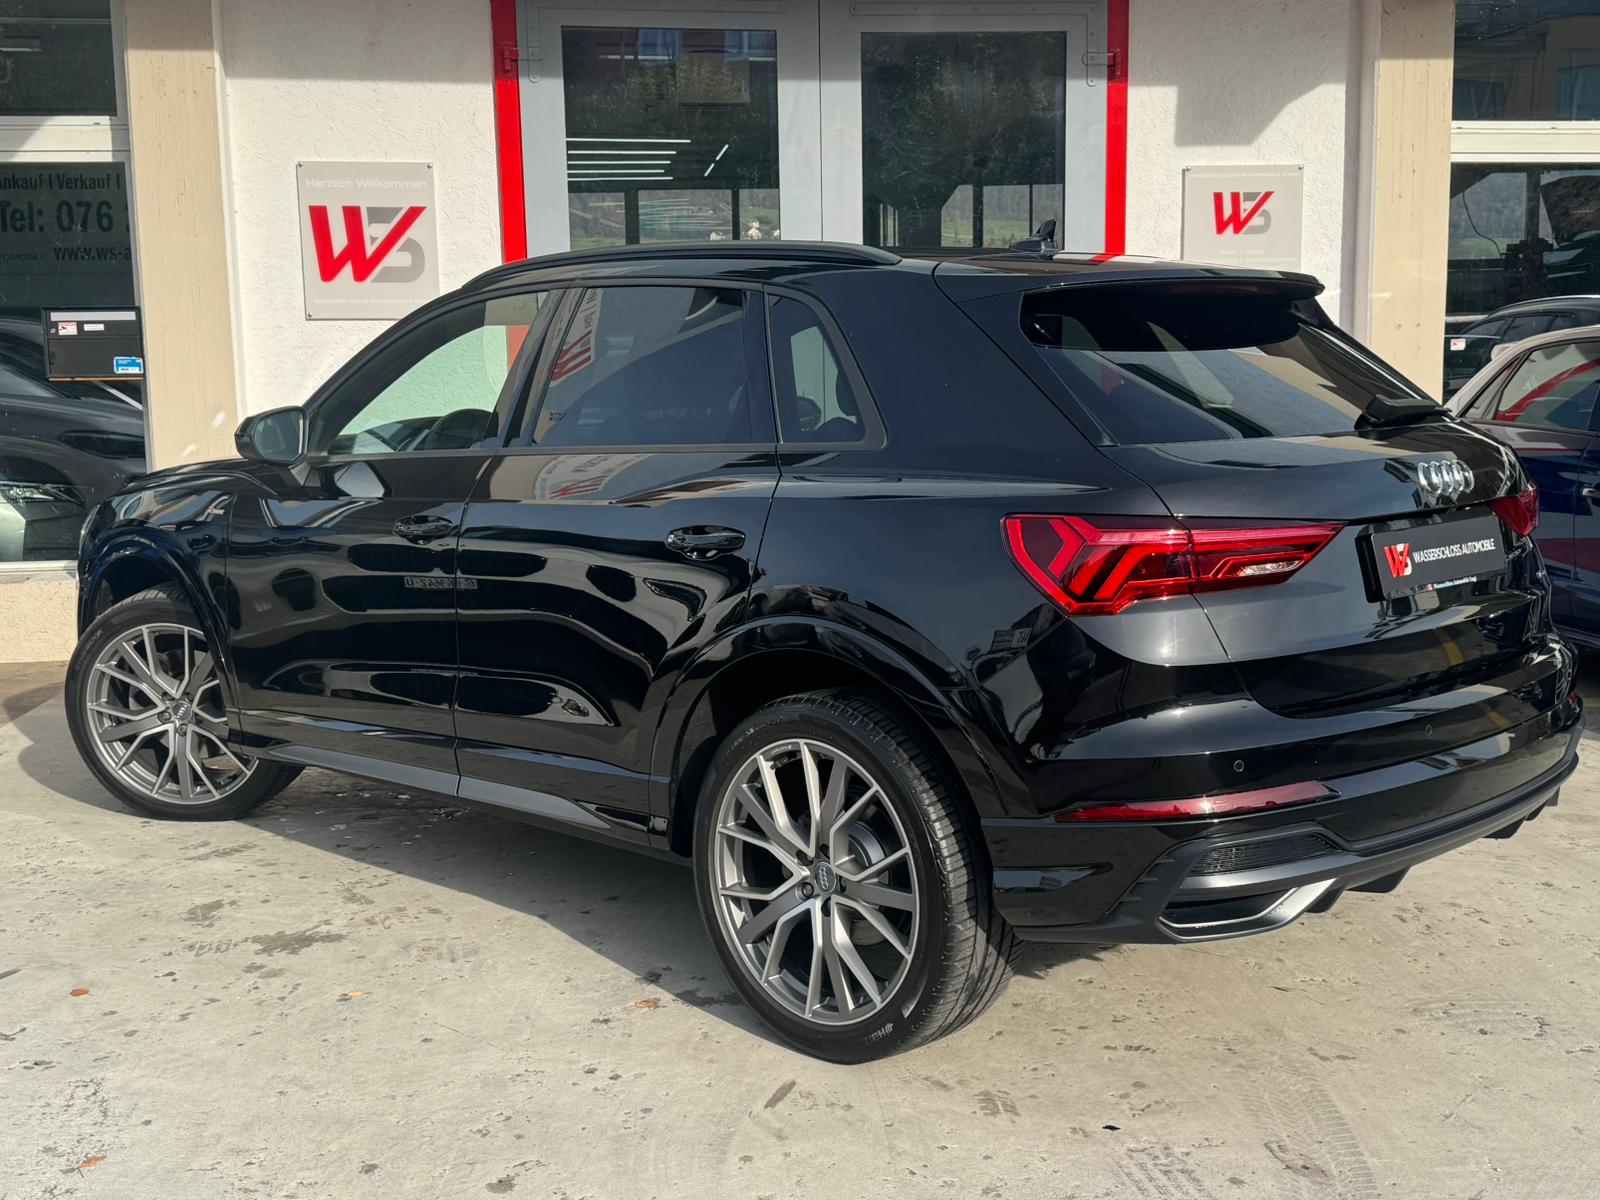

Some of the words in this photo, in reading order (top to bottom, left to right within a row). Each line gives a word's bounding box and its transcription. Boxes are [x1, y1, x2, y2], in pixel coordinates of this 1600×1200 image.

[0, 173, 44, 190] nkauf
[56, 173, 112, 190] Verkauf
[306, 176, 352, 189] Herzlich
[355, 176, 428, 189] Willkommen
[0, 201, 44, 233] Tel:
[56, 200, 114, 233] 076
[1413, 544, 1462, 563] WASSERSCHLOSS
